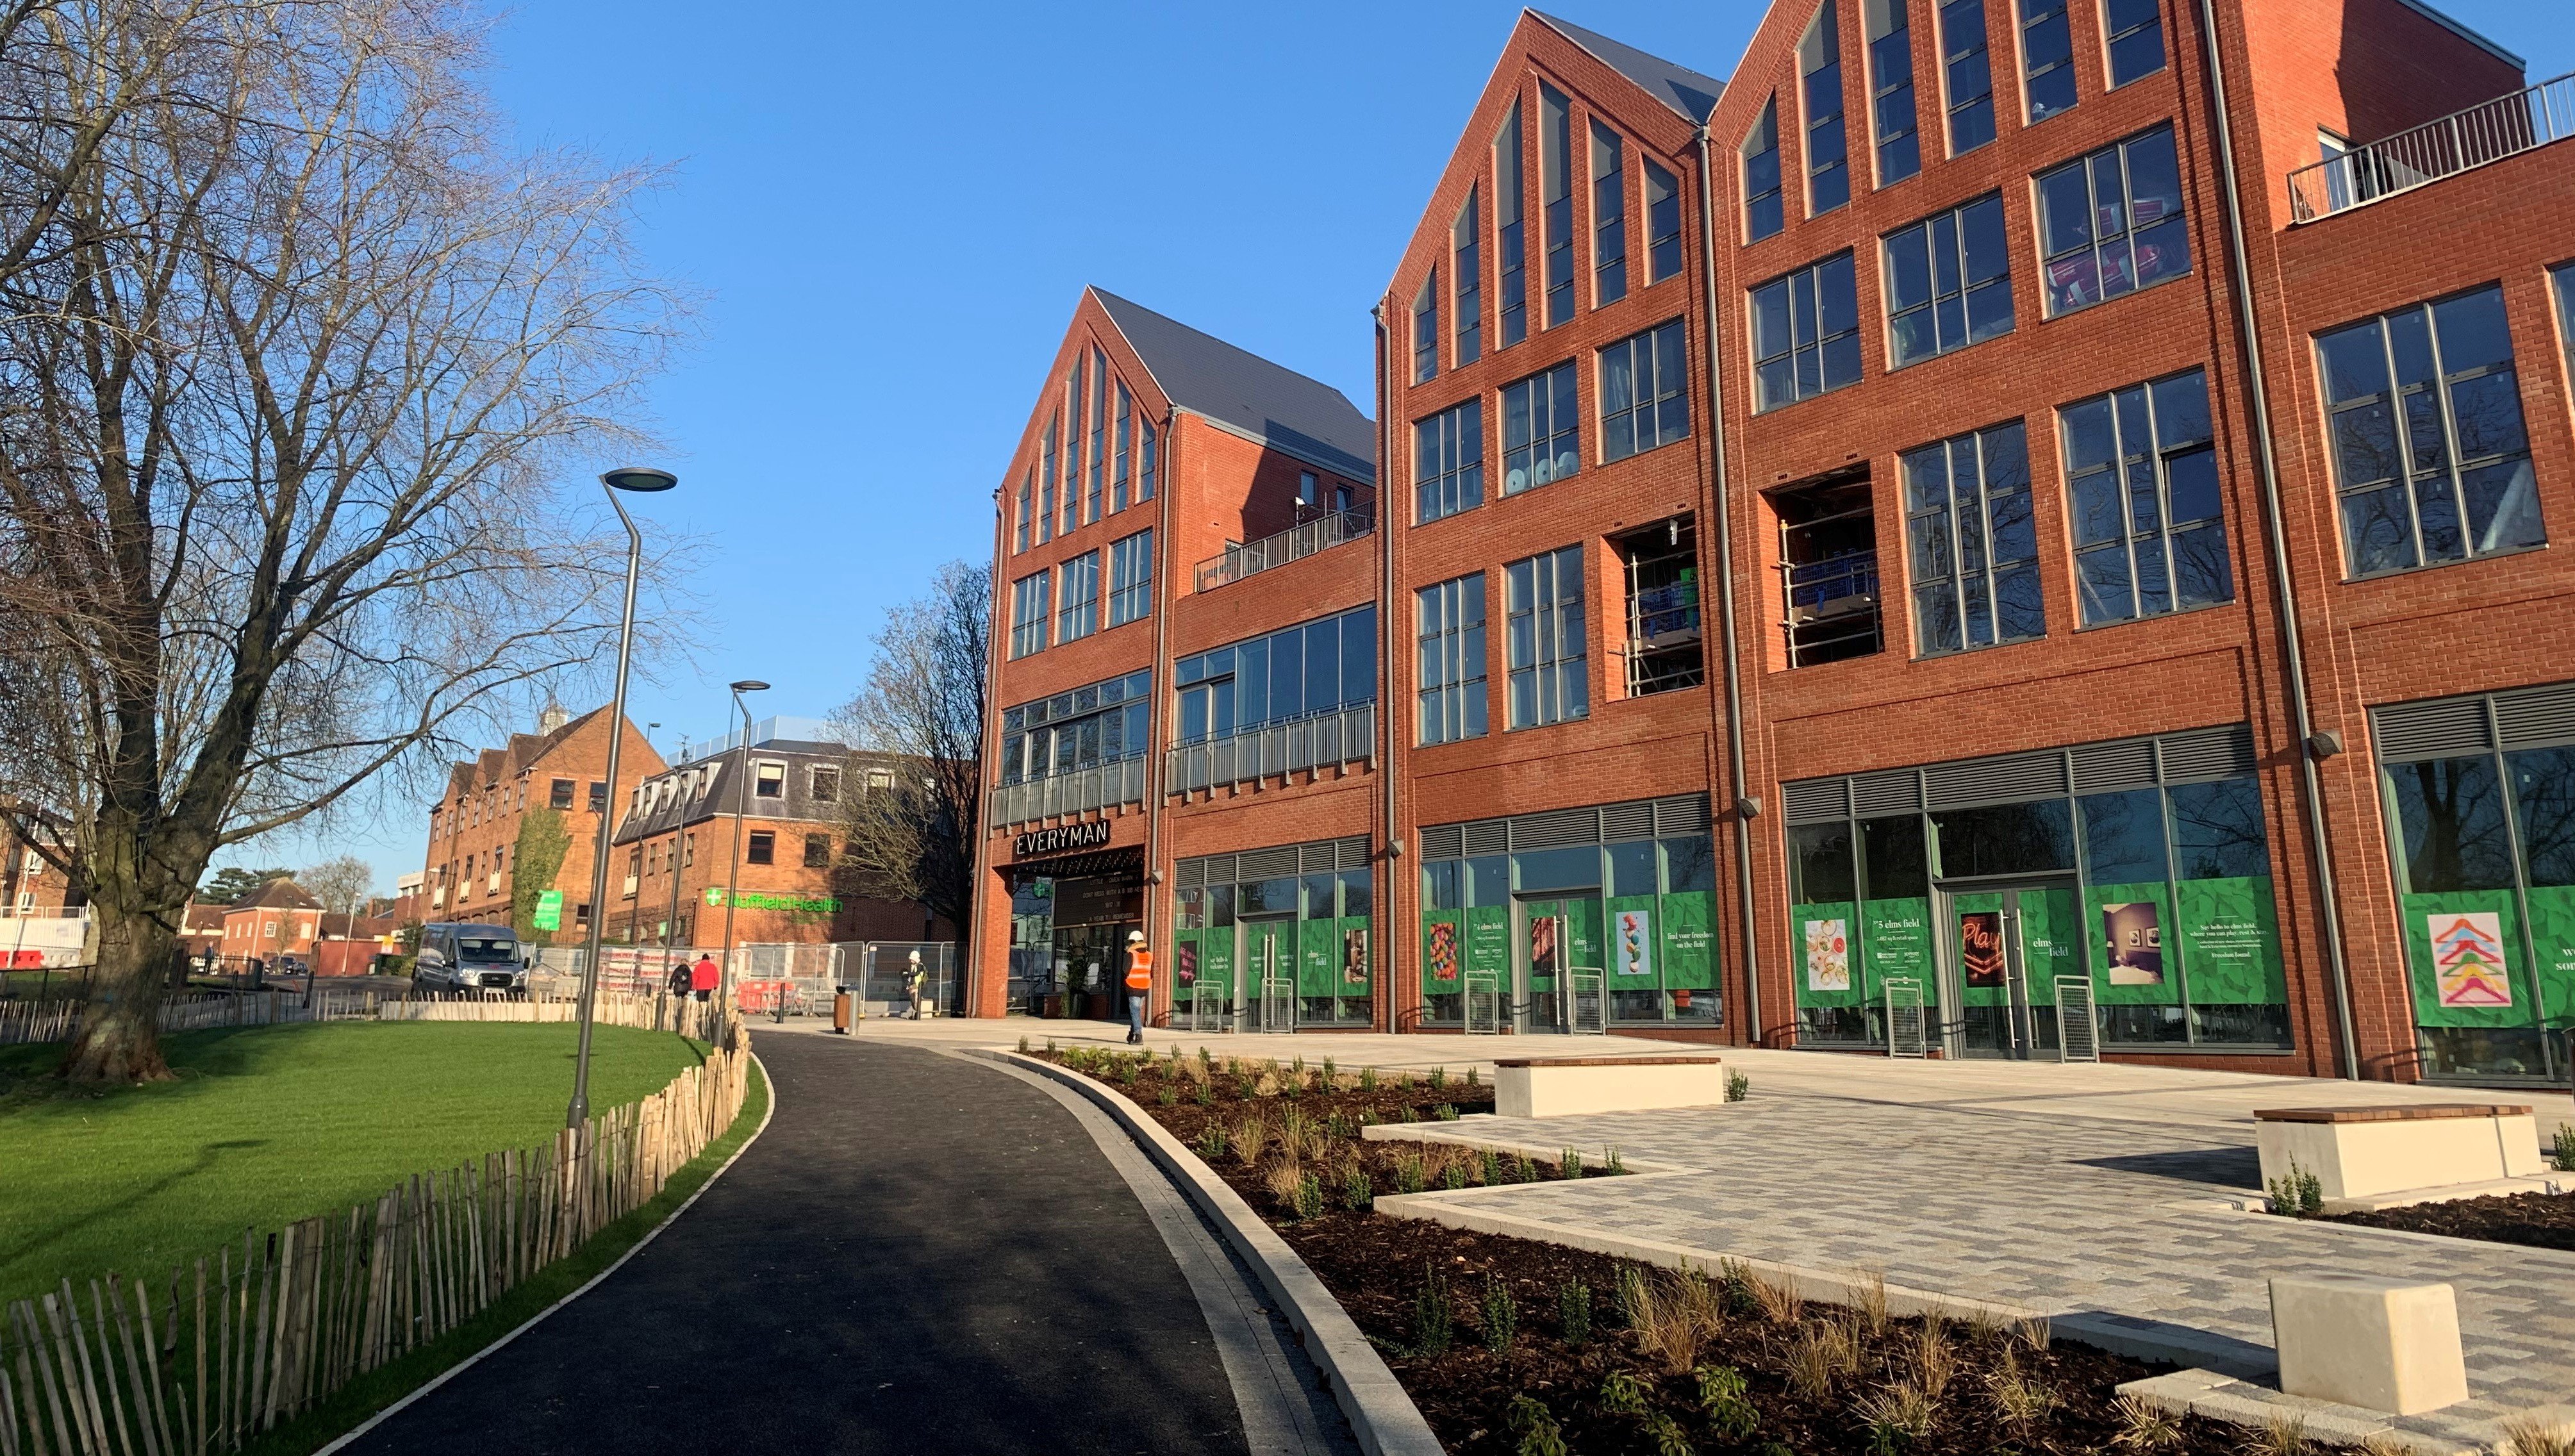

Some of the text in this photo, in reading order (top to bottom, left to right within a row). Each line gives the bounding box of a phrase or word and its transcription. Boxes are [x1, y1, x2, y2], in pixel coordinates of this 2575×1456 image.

[1016, 821, 1106, 855] EVERYMAN
[1885, 920, 1901, 929] elms
[1903, 918, 1919, 928] field
[1962, 923, 2001, 962] Play
[2033, 938, 2053, 947] elms
[2049, 947, 2069, 957] field
